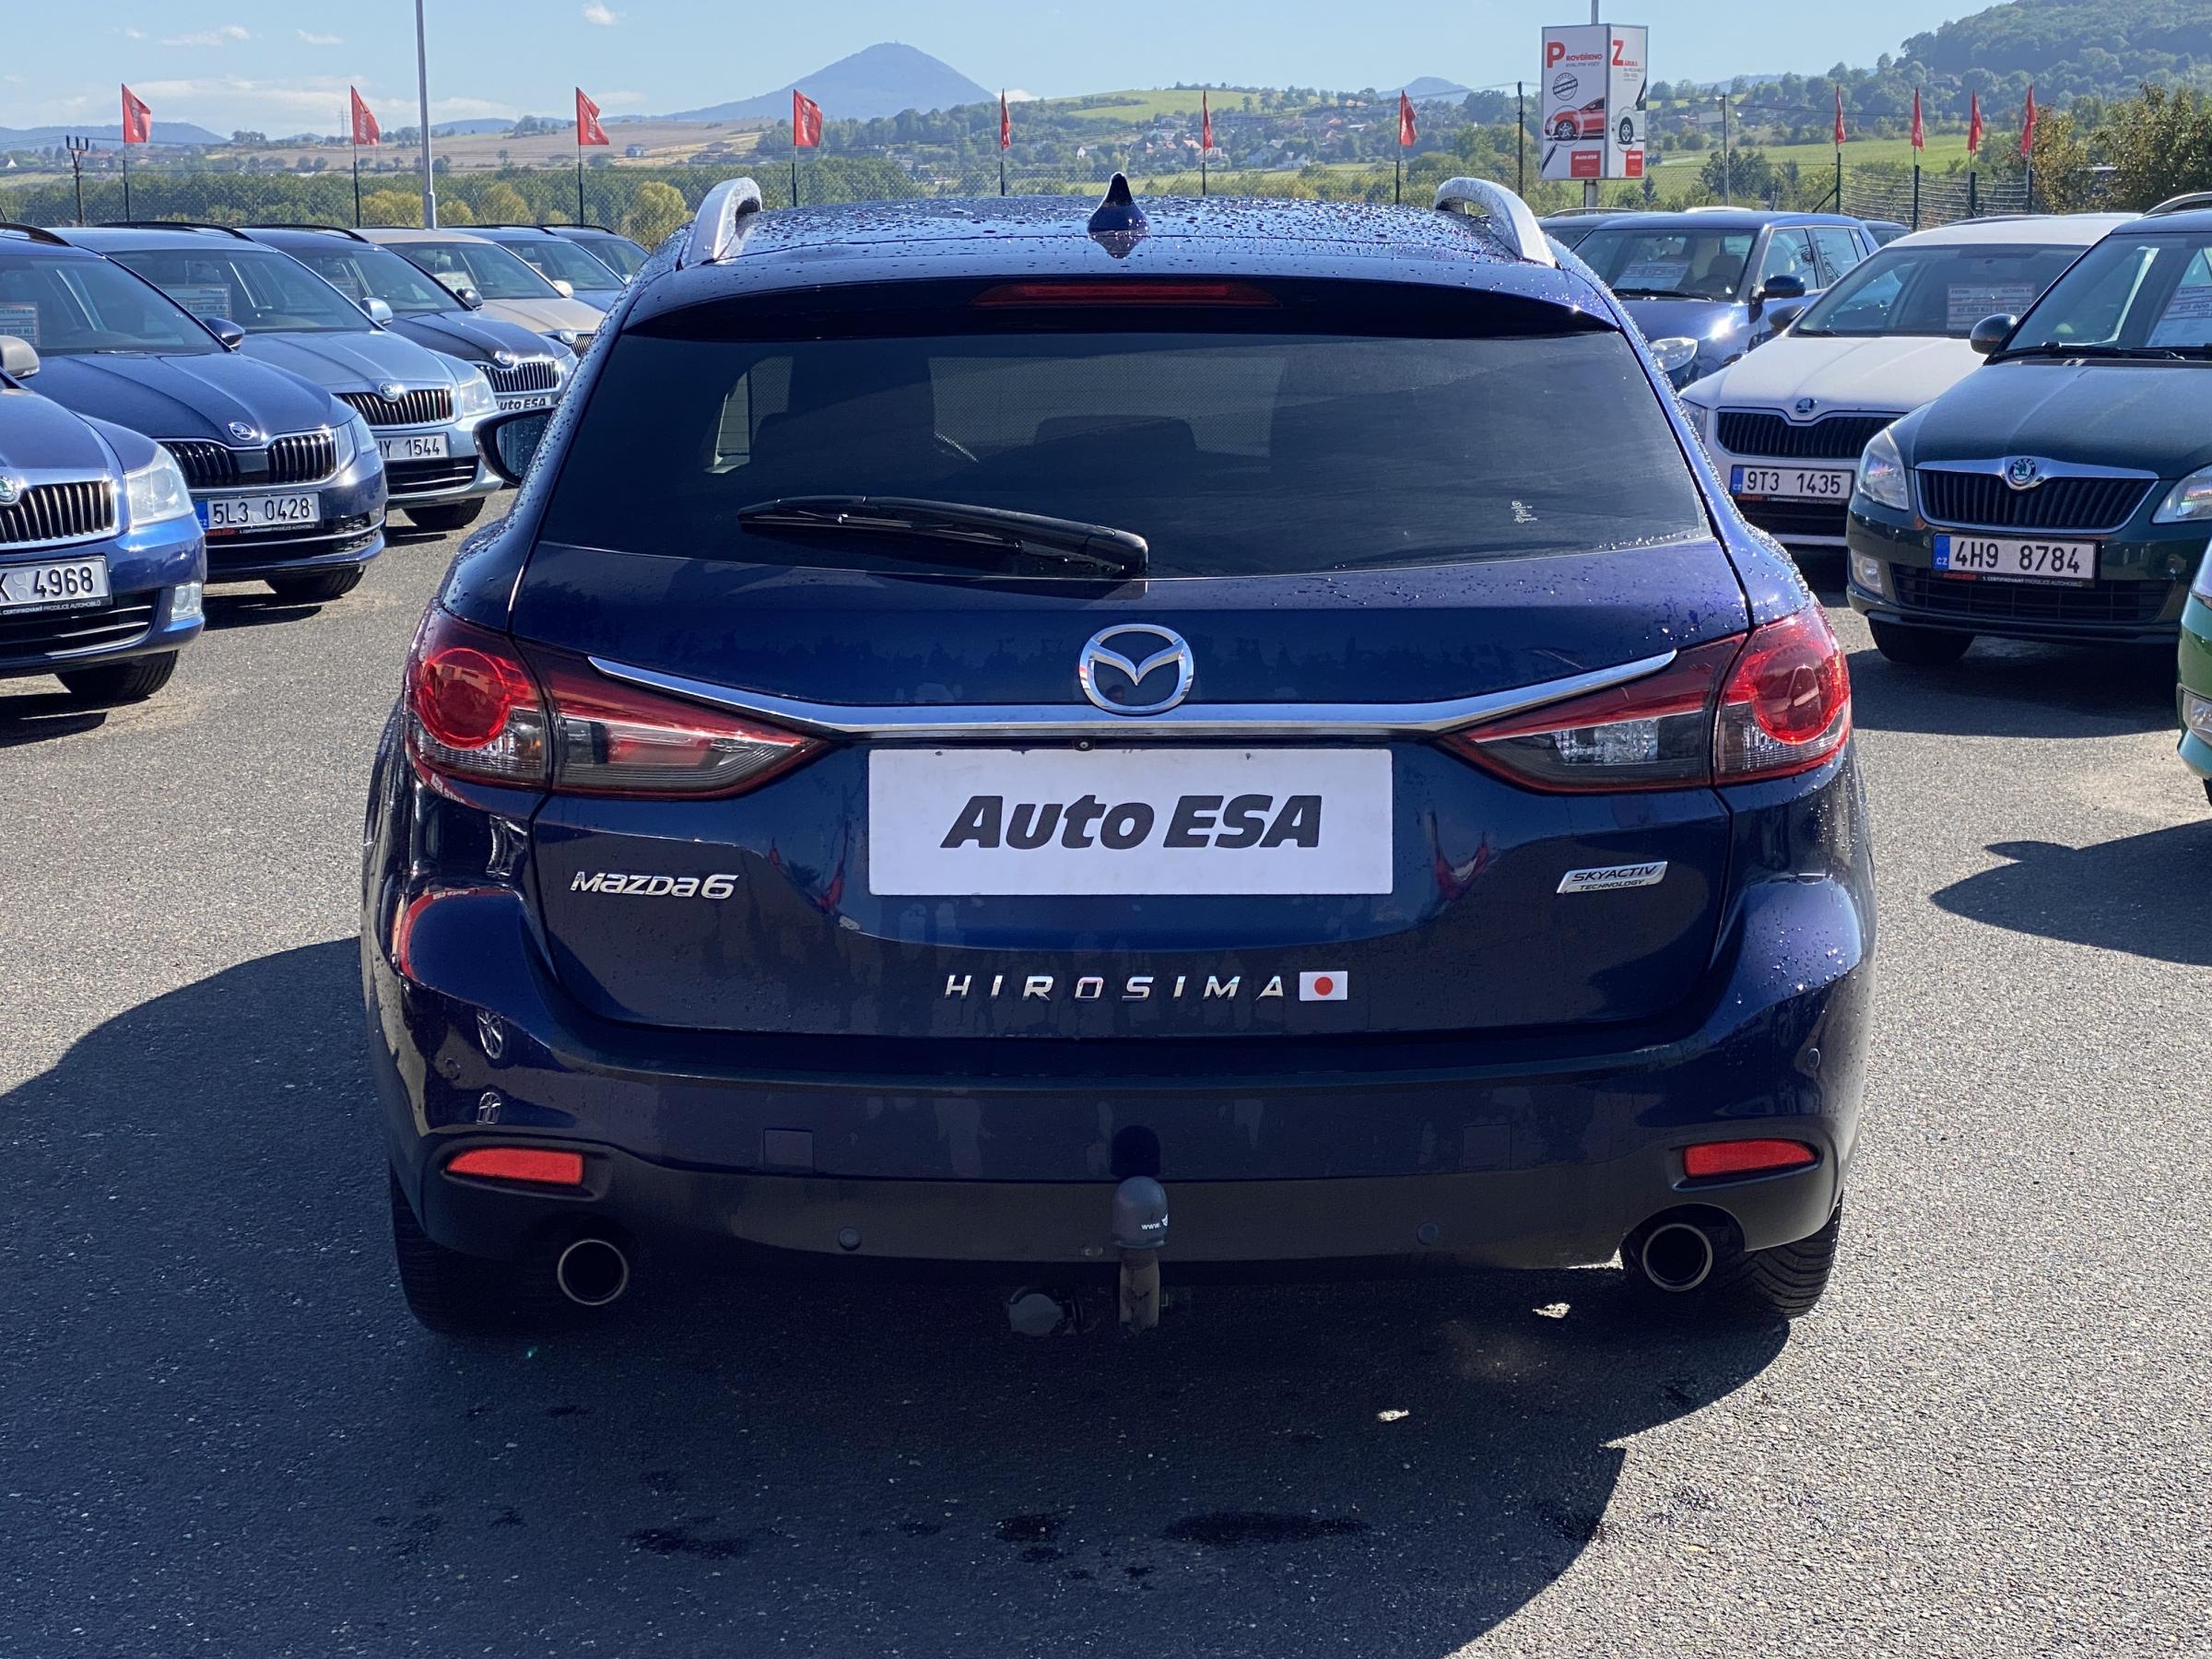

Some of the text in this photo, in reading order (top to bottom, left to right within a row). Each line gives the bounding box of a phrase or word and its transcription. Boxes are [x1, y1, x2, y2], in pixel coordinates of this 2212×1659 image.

[497, 397, 546, 411] uto ESA
[406, 438, 440, 457] 1544
[1747, 471, 1841, 494] 9T3 1435
[213, 498, 310, 524] 5L3 0428
[1936, 557, 1947, 566] CZ
[1955, 541, 2080, 573] 4H9 8784
[34, 566, 93, 597] 4968
[939, 794, 1323, 850] Auto ESA
[1571, 866, 1657, 882] SKYACTIV
[1580, 880, 1644, 890] TECHNOLOGY
[944, 974, 1285, 1002] HIROSIMA
